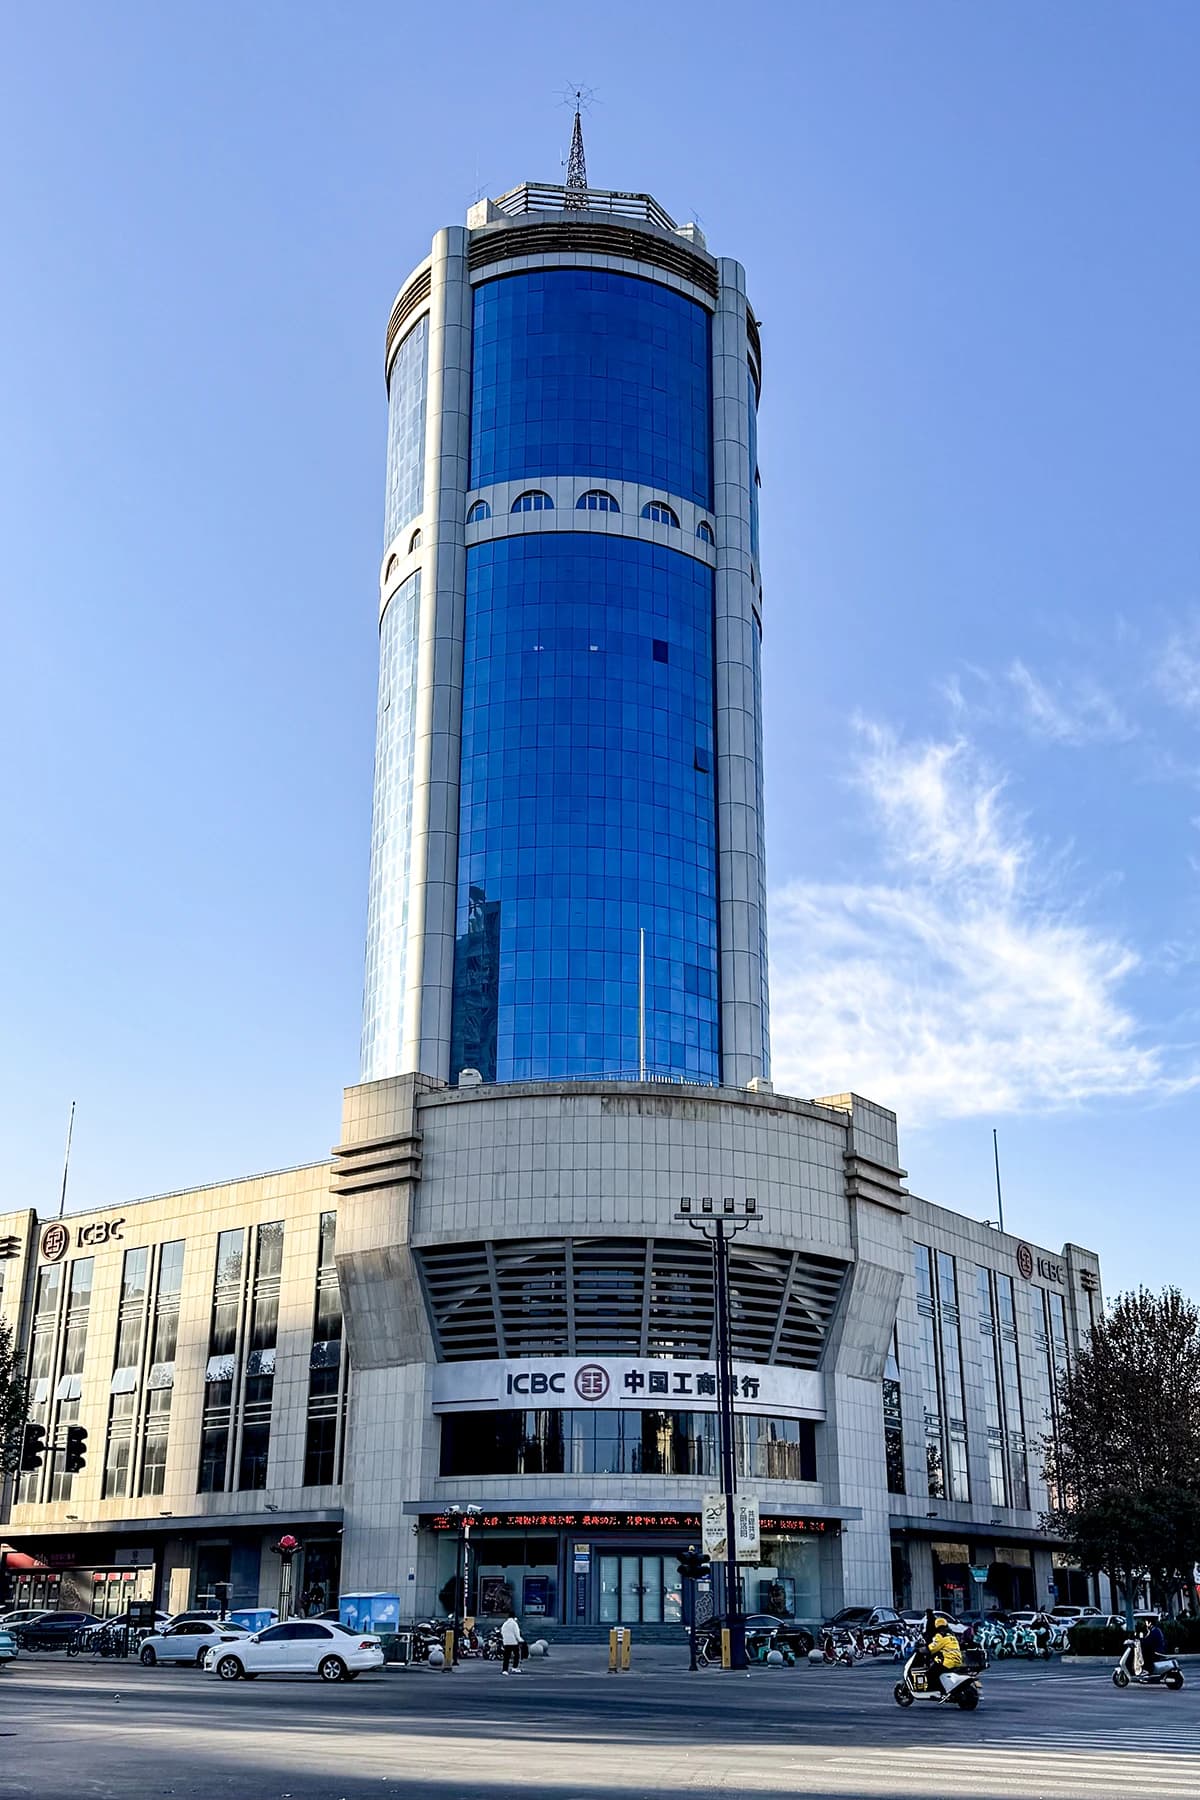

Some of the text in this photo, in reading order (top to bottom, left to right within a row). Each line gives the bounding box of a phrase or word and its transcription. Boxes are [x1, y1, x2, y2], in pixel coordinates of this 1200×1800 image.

[77, 1217, 126, 1248] ICBC
[1037, 1256, 1065, 1285] ICBC
[506, 1373, 566, 1395] ICBC
